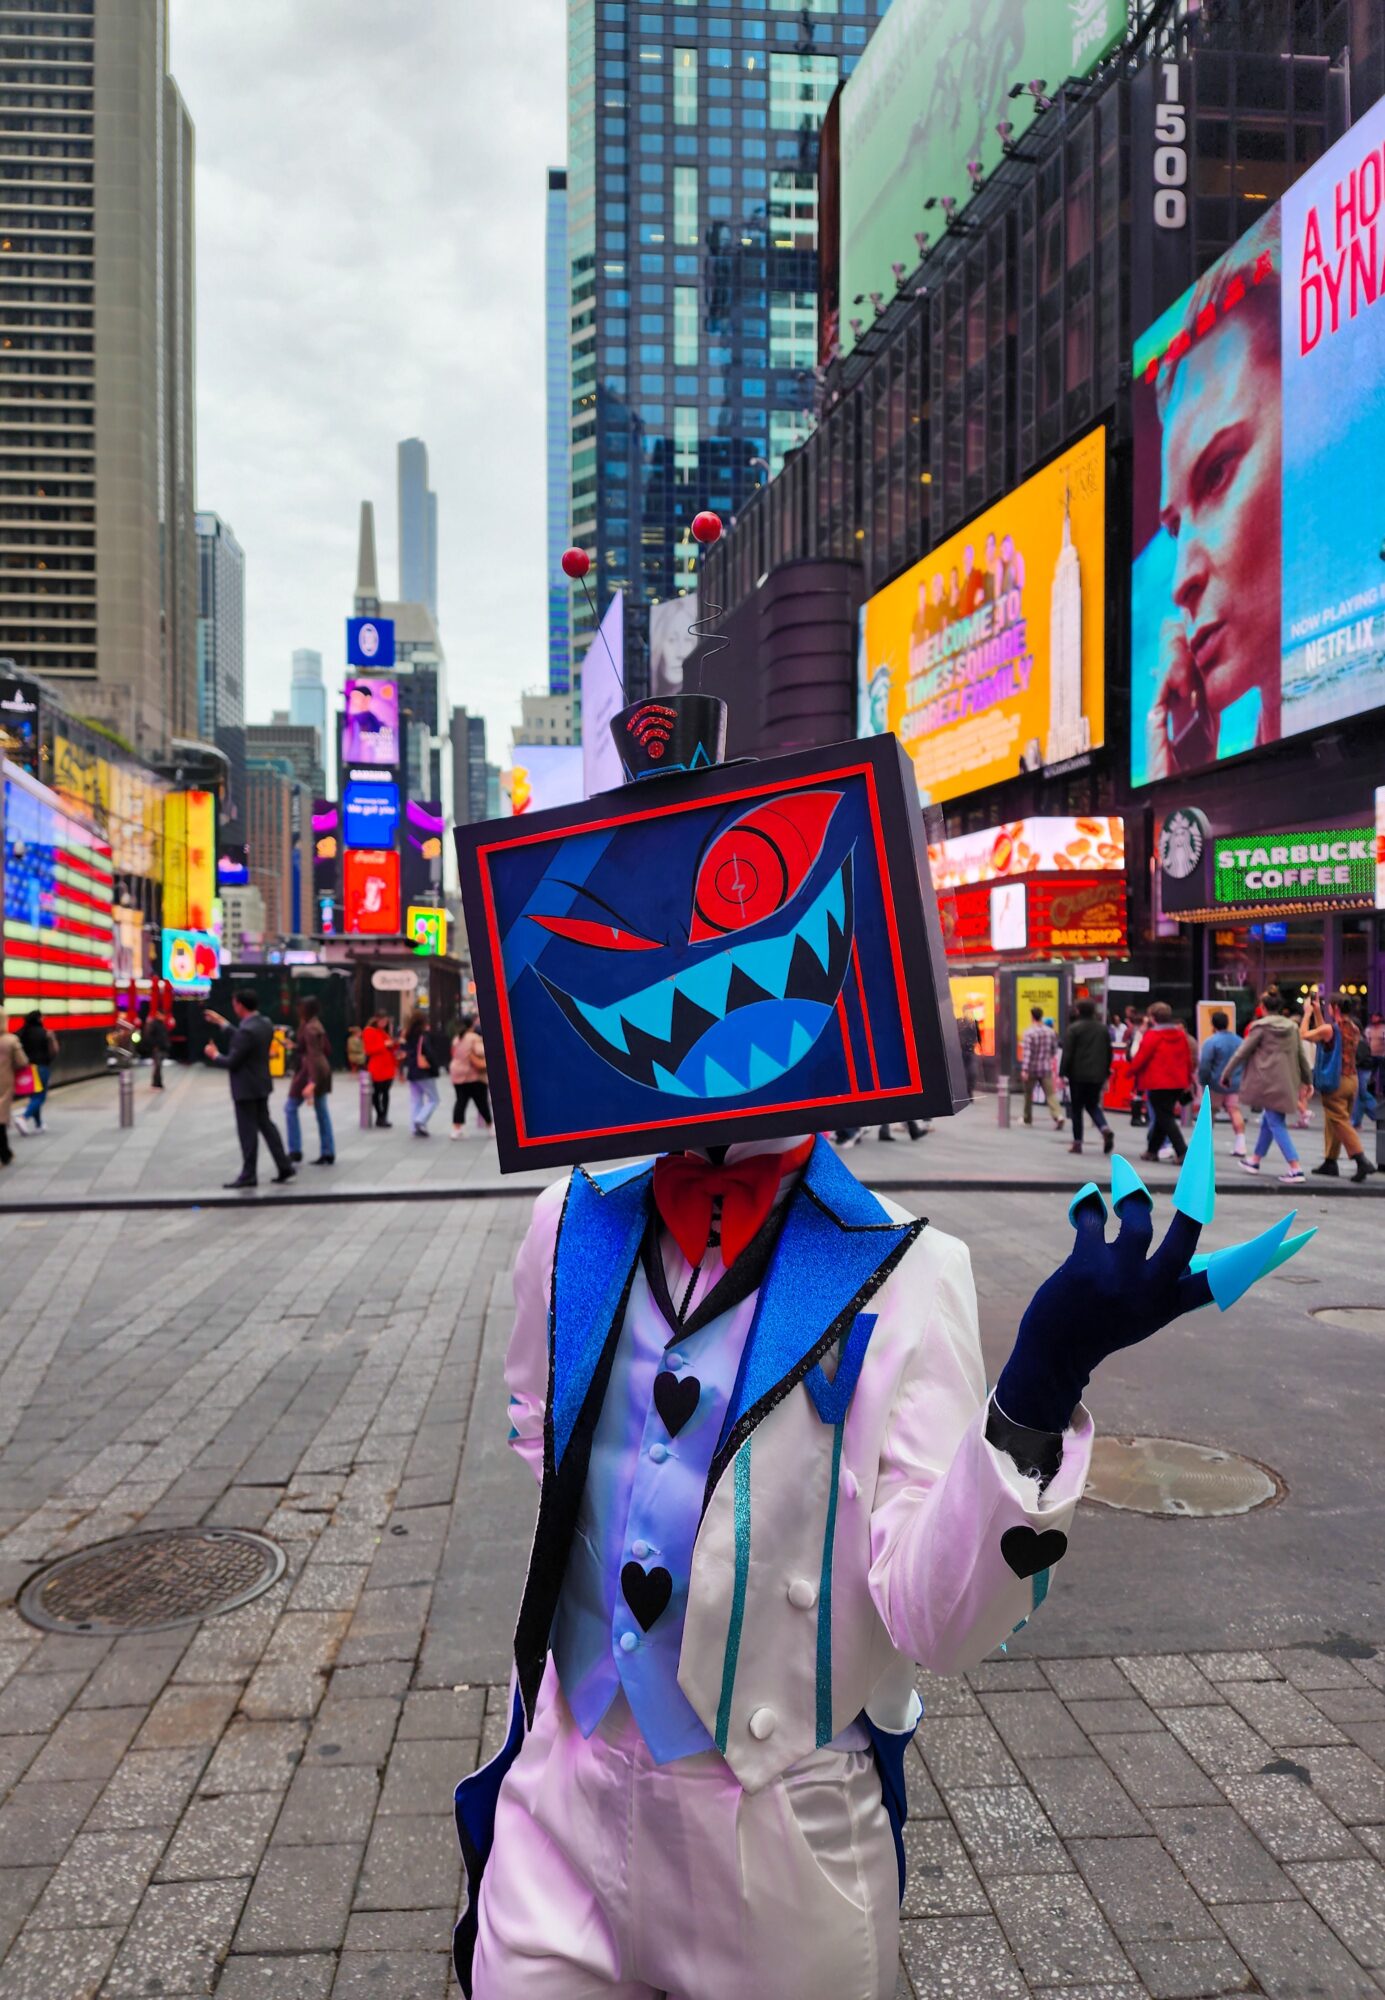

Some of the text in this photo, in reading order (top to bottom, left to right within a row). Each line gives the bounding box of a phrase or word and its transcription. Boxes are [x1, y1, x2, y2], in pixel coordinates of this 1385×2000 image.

[1154, 64, 1187, 229] 1500
[1300, 140, 1385, 281] A HO
[910, 587, 1021, 677] WELCOME TO
[1291, 612, 1320, 638] NOW
[1322, 588, 1377, 624] PLAYING
[1305, 616, 1374, 672] NETFLIX
[905, 619, 1026, 709] TIMES SQUARE
[961, 654, 1033, 718] FAMILY
[1245, 866, 1350, 890] COFFEE
[1051, 928, 1122, 945] BAKE SHOP
